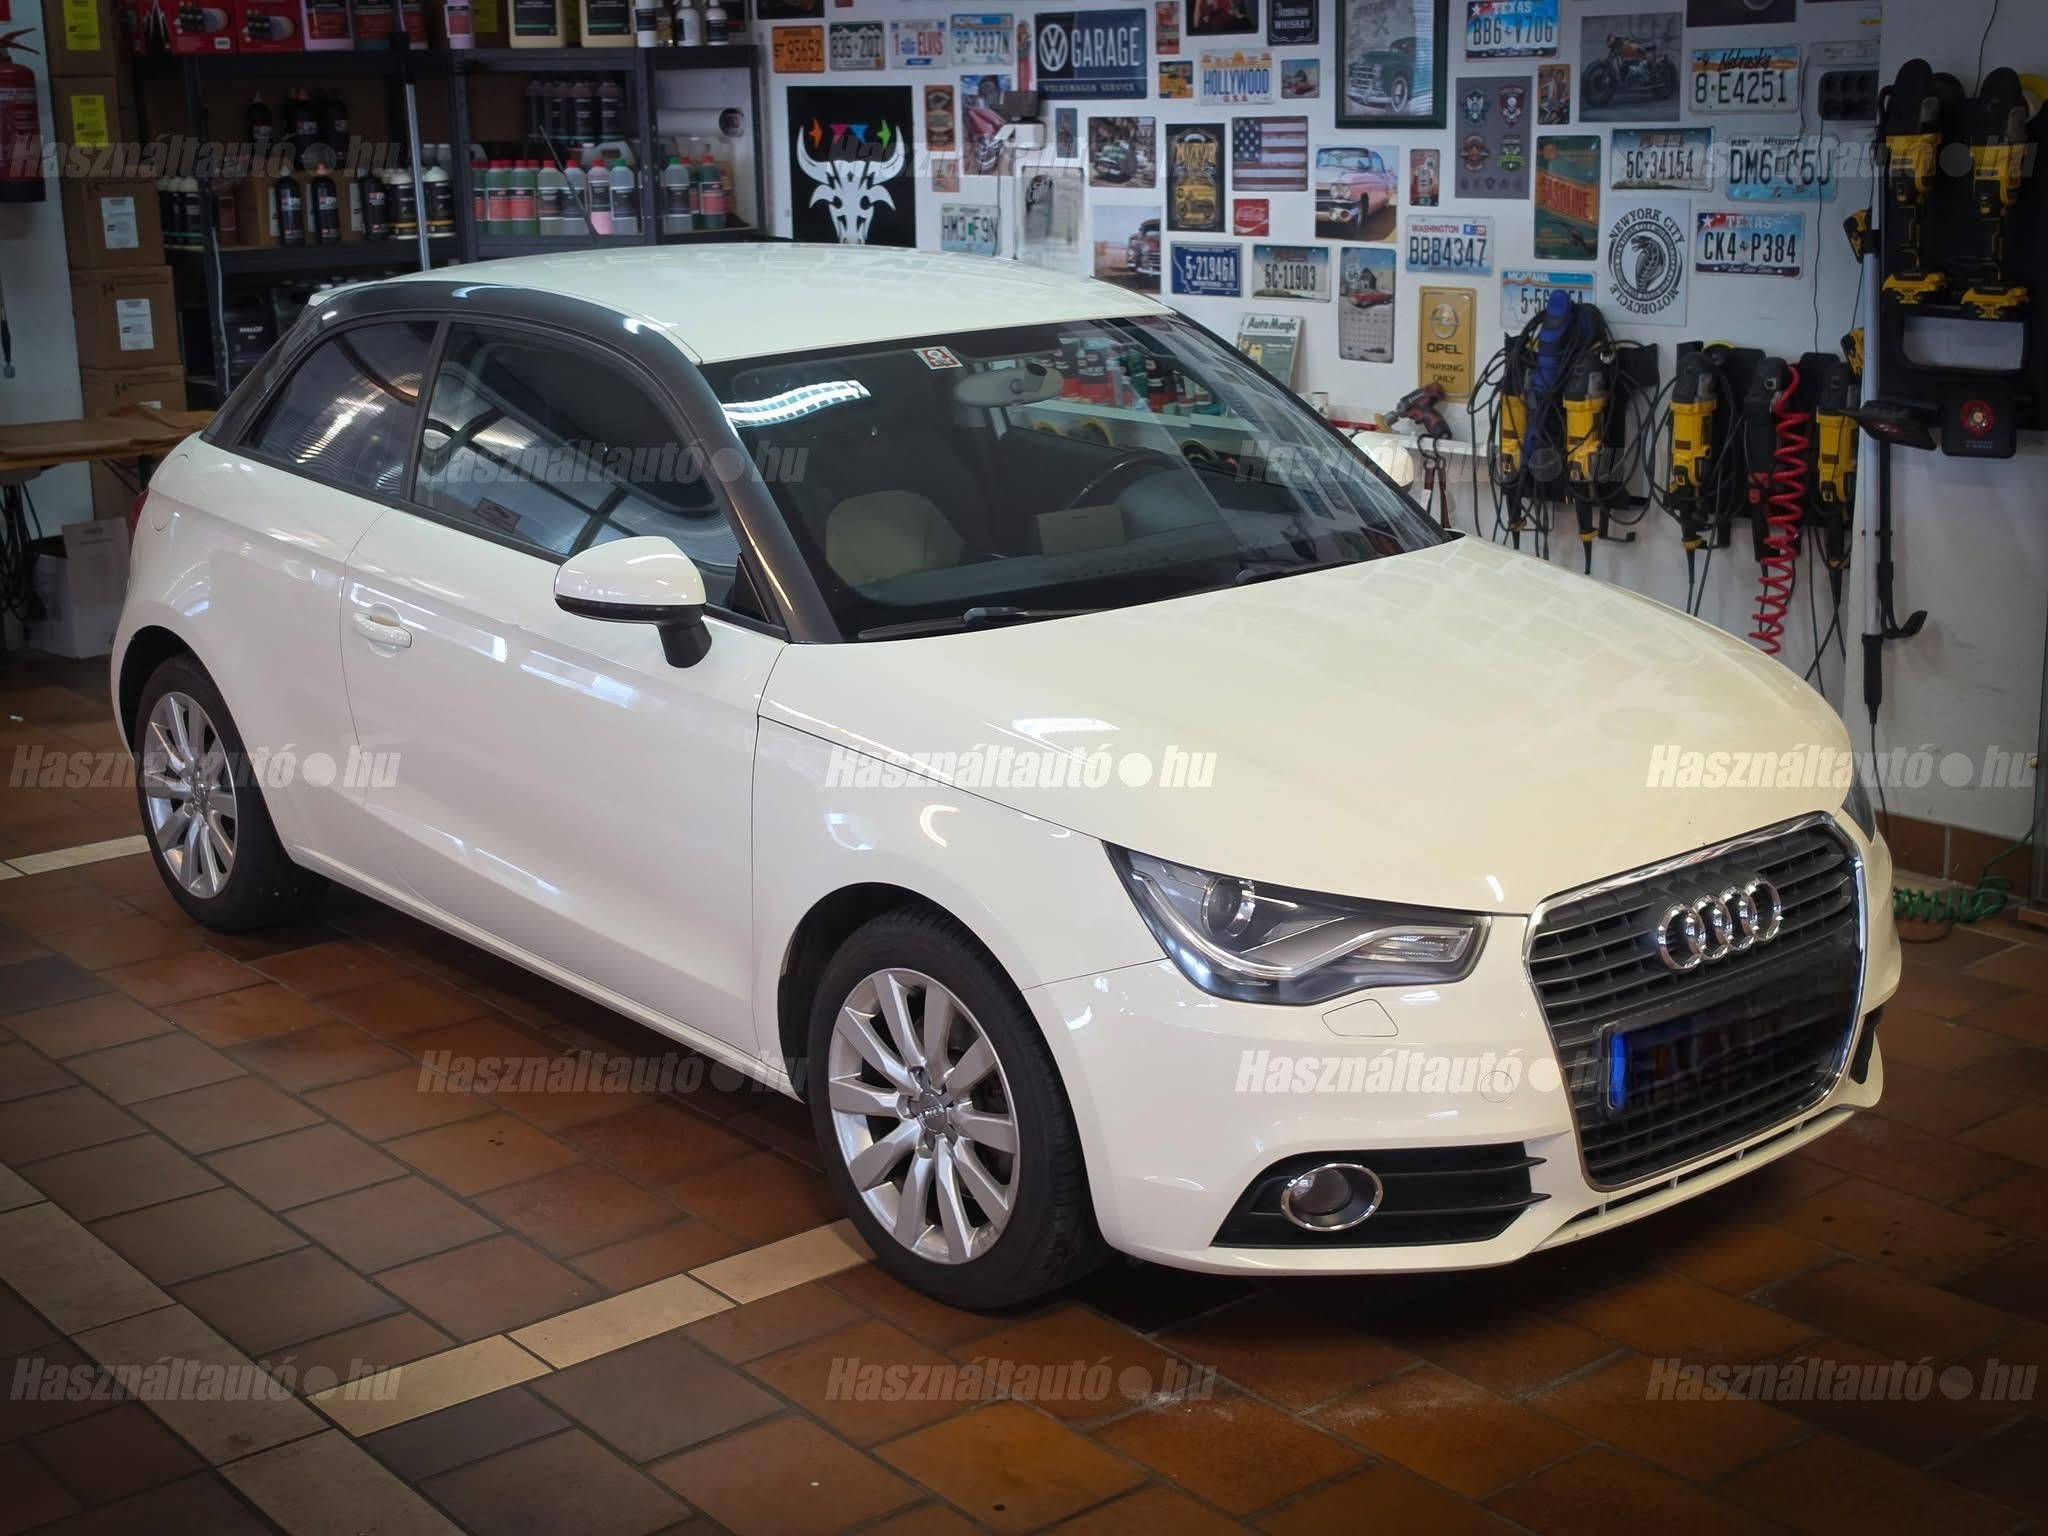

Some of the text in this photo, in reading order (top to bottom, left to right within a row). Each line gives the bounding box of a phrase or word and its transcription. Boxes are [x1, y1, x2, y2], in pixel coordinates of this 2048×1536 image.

[1491, 0, 1532, 14] TEXAS
[1071, 26, 1140, 68] GARAGE
[1203, 67, 1270, 96] HOLLYWOOD
[1729, 148, 1774, 185] DM6
[1411, 224, 1459, 234] WASHINGTON
[1663, 216, 1686, 244] CITY
[1726, 215, 1772, 229] TEXAS
[1408, 236, 1487, 268] BBB4347
[1703, 231, 1737, 262] CK4
[1750, 232, 1797, 264] P384
[1609, 282, 1681, 315] MOTORCYCLE
[1247, 316, 1297, 334] Auto Magic
[1426, 342, 1463, 355] OPEL
[1425, 362, 1464, 374] PARKING
[1432, 373, 1456, 384] ONLY
